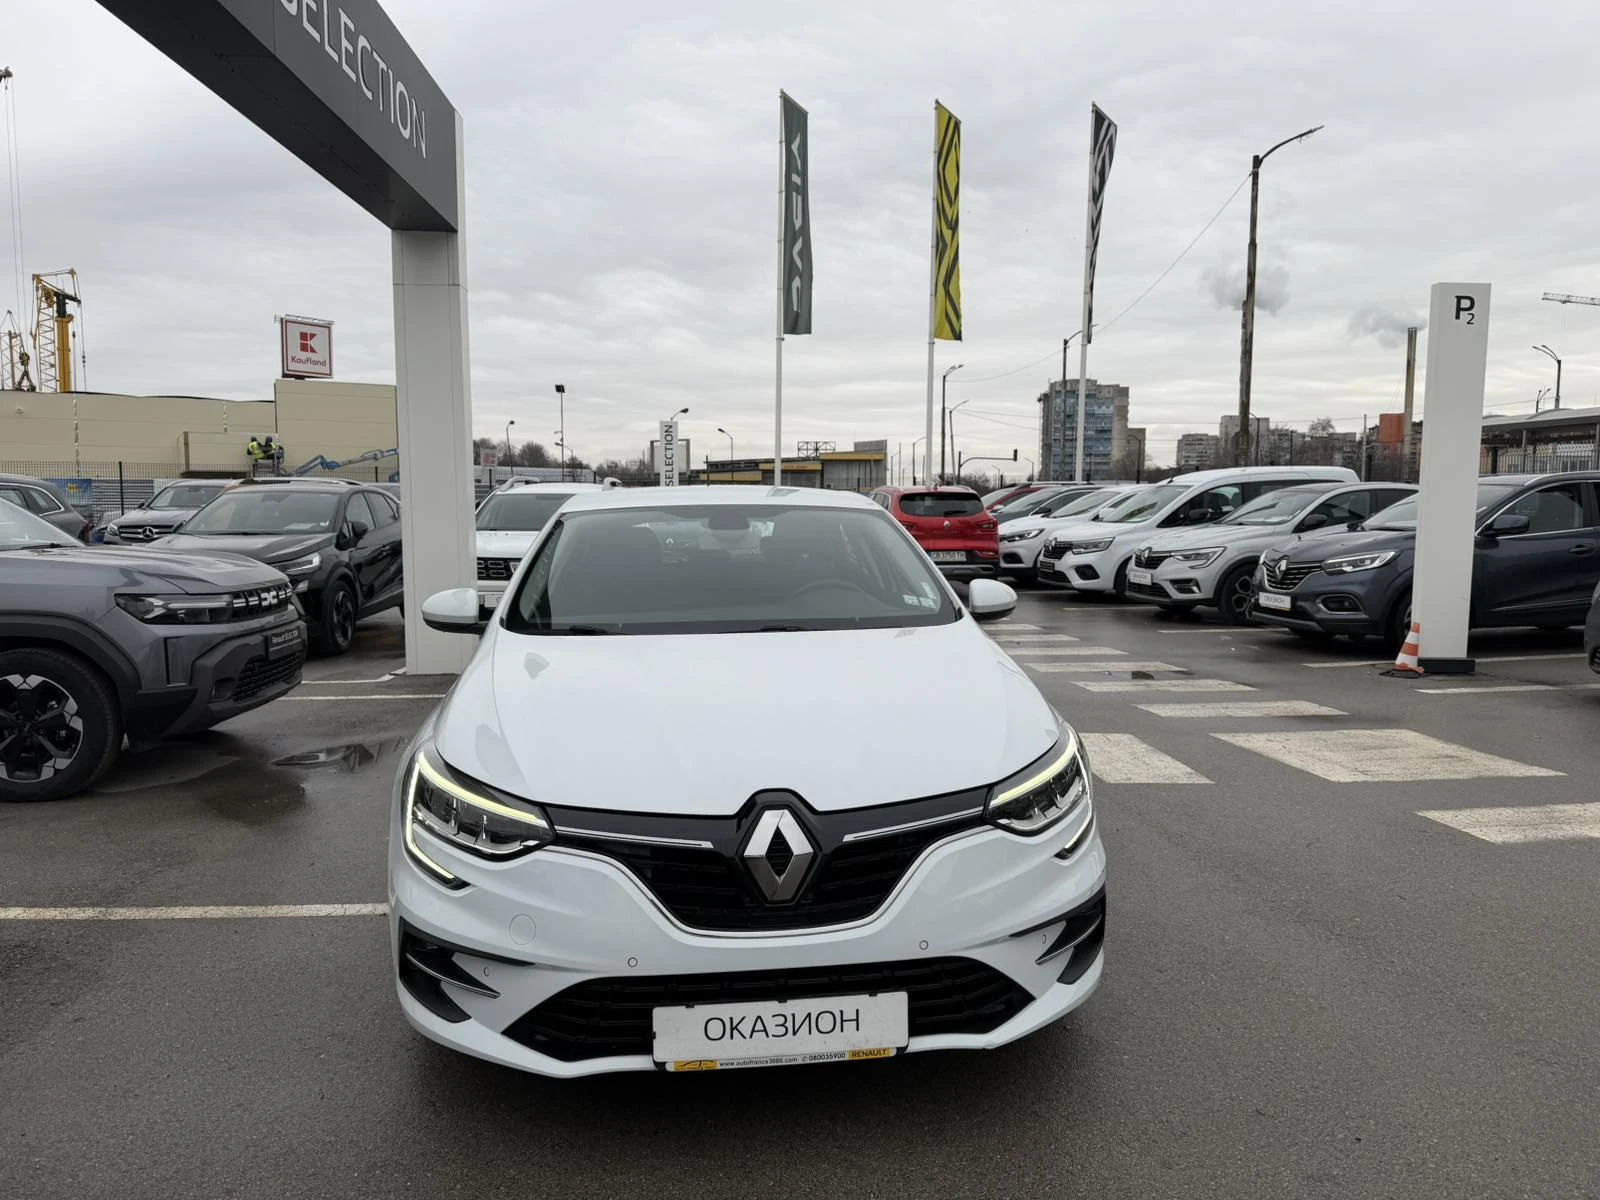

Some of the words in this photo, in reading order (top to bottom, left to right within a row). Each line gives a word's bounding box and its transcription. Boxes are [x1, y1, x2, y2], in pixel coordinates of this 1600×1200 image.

[281, 0, 427, 159] ELECTION
[290, 355, 327, 367] Kaufland
[664, 424, 674, 486] SELECTION
[704, 1008, 861, 1041] ОКАЗИОН
[719, 1057, 798, 1067] www.autofrance3000.com
[851, 1048, 887, 1058] RENAULT
